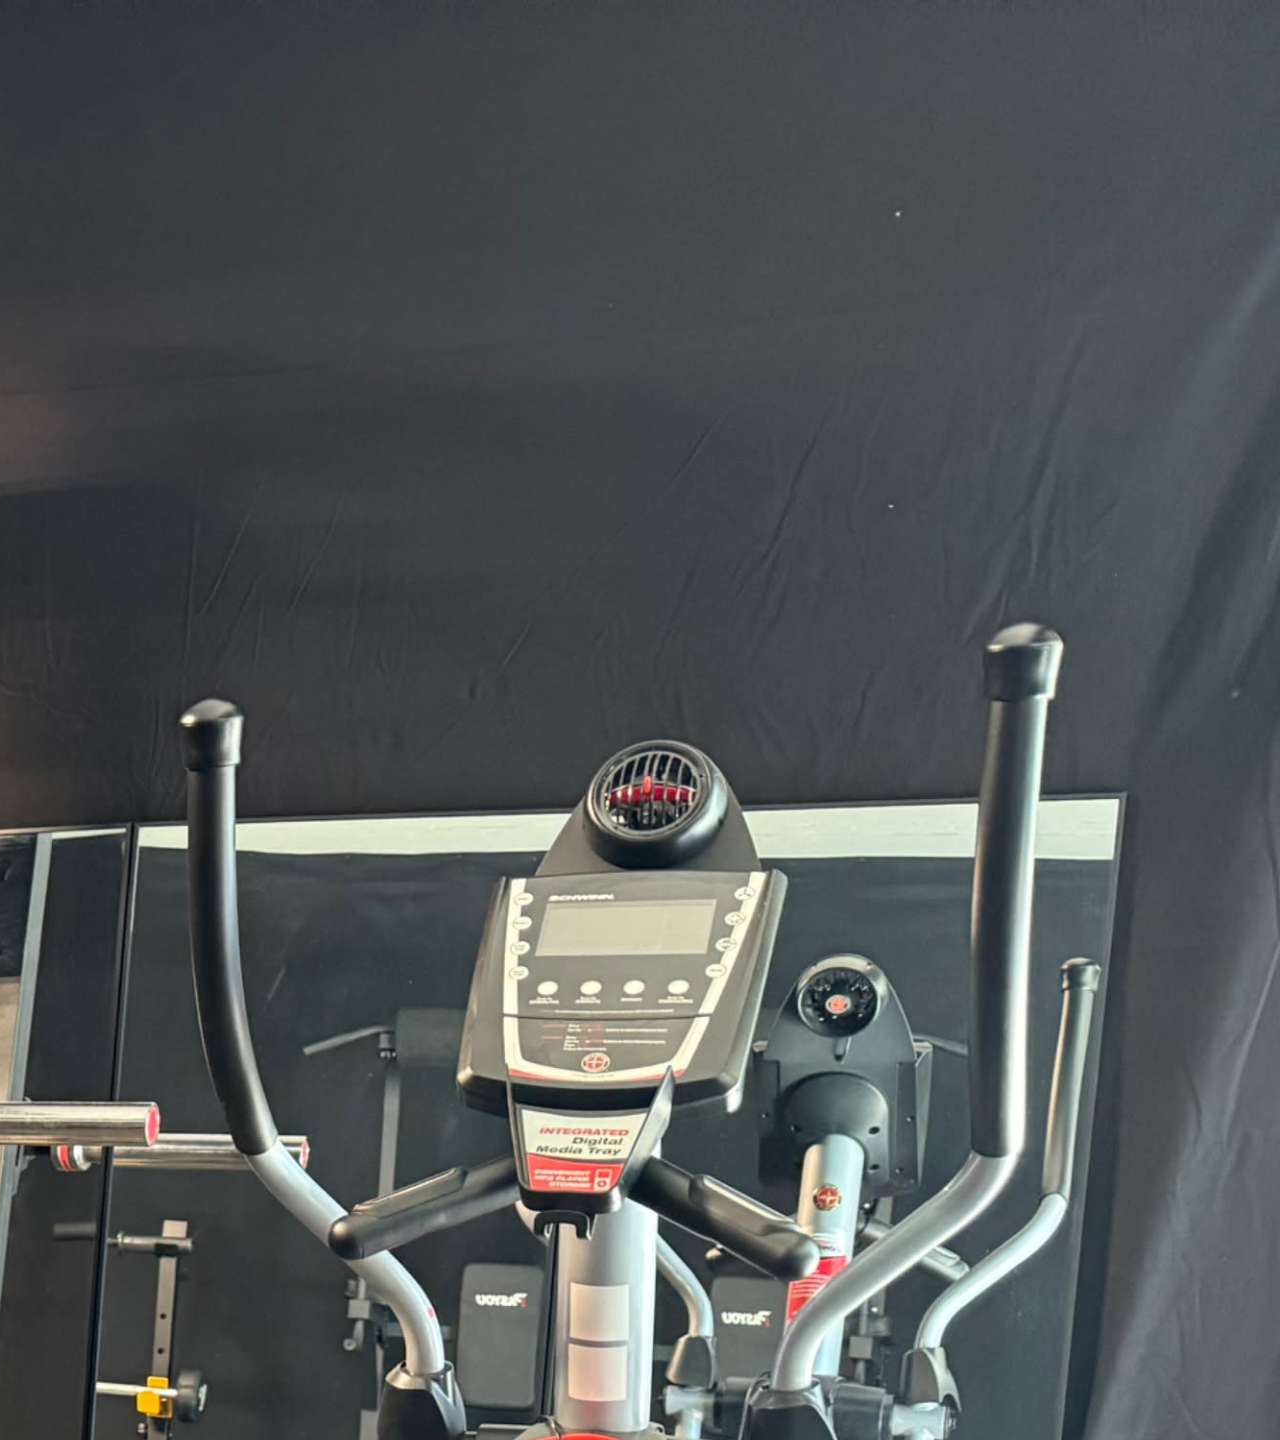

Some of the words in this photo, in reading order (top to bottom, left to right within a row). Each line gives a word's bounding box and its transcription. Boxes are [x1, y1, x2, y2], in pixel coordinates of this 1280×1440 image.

[539, 1127, 629, 1136] INTEGRATED
[572, 1137, 624, 1146] Digital
[536, 1145, 582, 1154] Media
[589, 1147, 622, 1156] Tray
